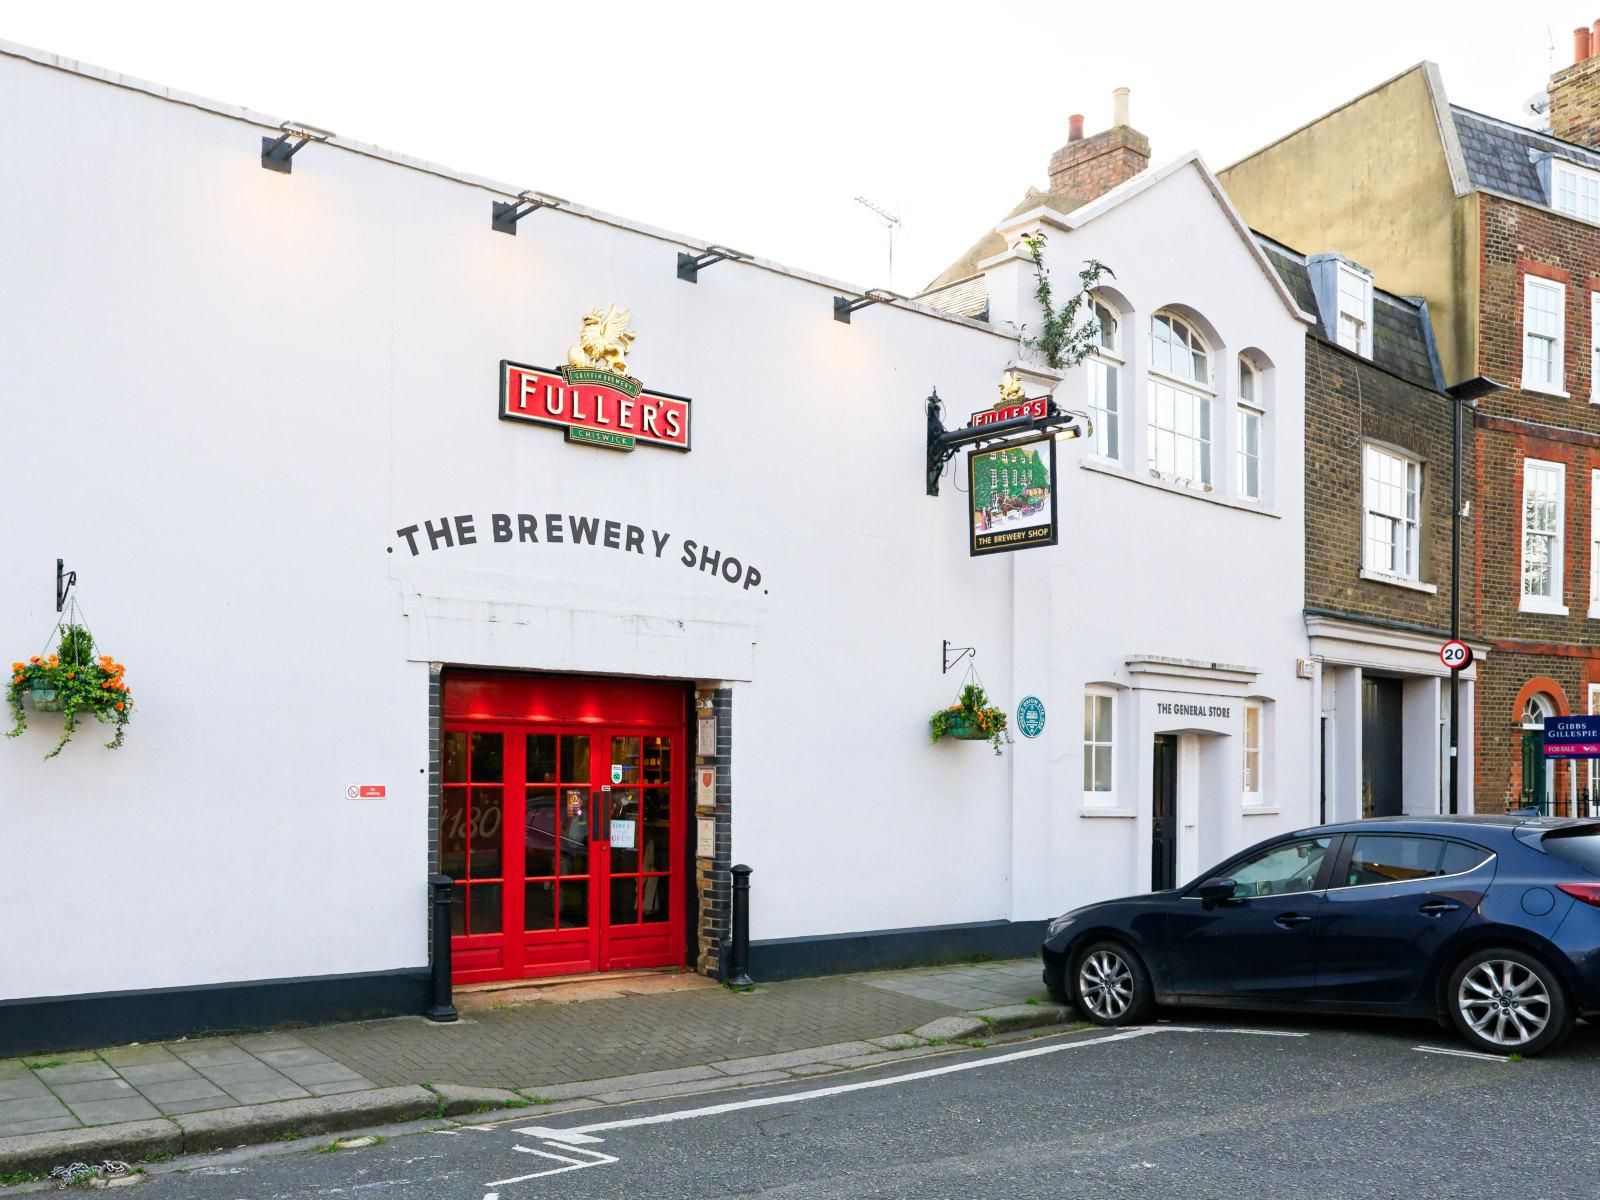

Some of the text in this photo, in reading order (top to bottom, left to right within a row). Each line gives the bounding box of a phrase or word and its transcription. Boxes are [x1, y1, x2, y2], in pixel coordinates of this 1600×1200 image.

[575, 372, 633, 389] GRIFFIN BREWERY
[520, 372, 681, 438] FULLER'S
[578, 429, 627, 445] CHISWICK
[396, 514, 478, 557] THE
[491, 513, 671, 558] BREWERY
[978, 528, 1049, 545] THE BREWERY SHOP
[1445, 648, 1464, 660] 20
[1157, 703, 1230, 718] THE GENERAL STORE
[1548, 730, 1598, 738] GILLESPIE
[1557, 722, 1587, 730] GIBBS
